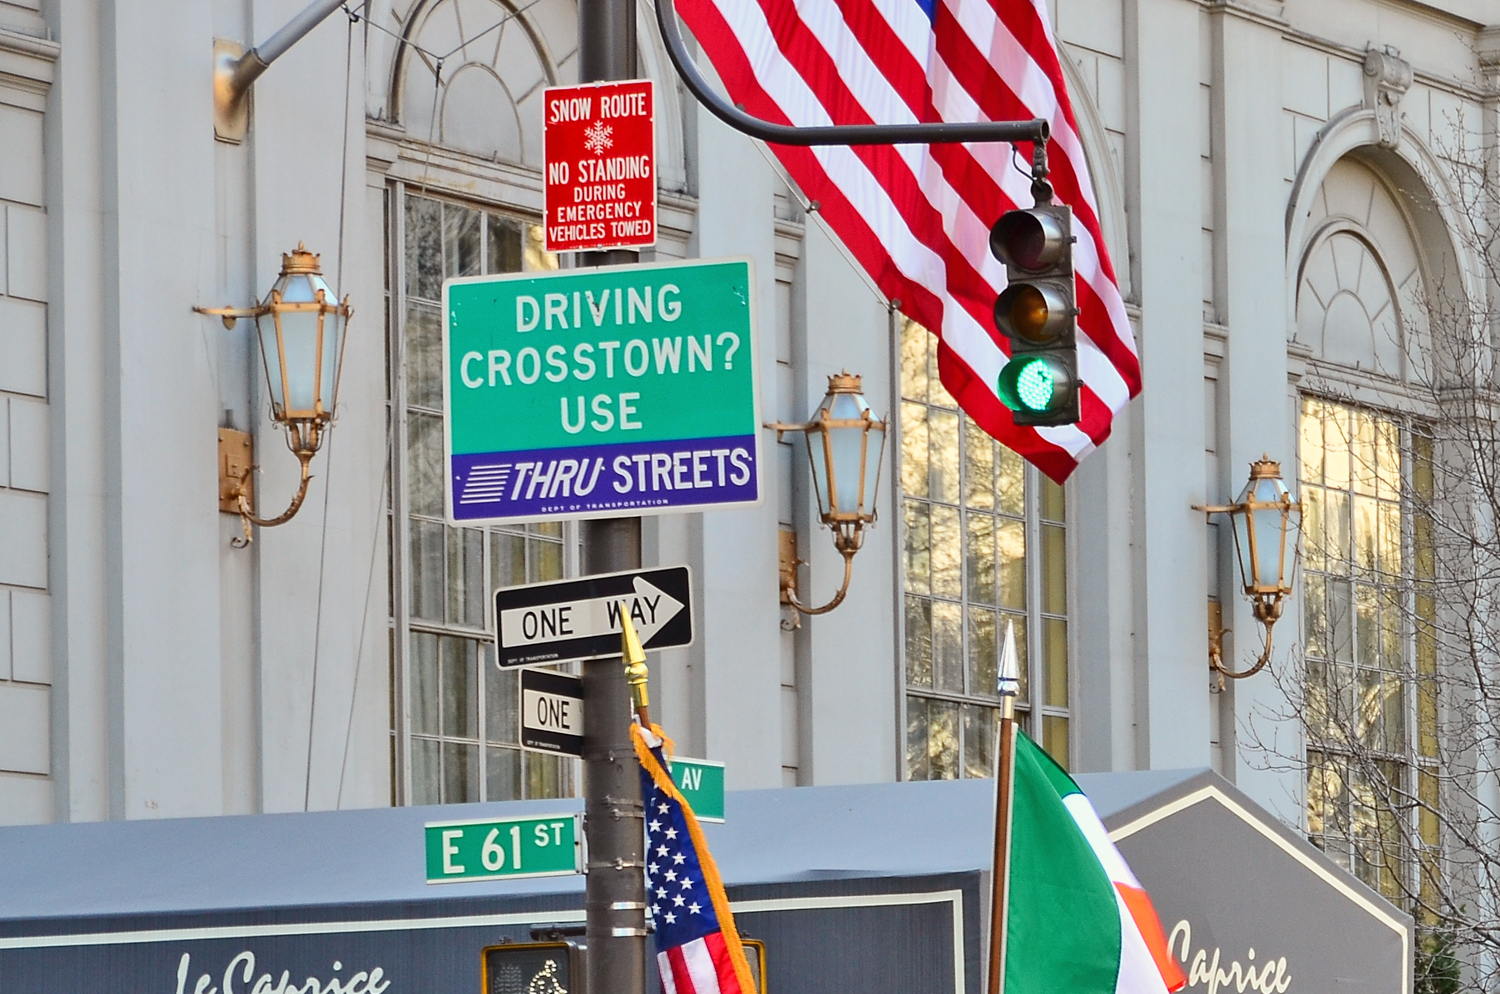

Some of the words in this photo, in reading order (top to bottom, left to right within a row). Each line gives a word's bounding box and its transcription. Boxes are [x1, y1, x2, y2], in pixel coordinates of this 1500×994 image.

[550, 97, 592, 123] SNOW
[600, 93, 647, 119] ROUTE
[549, 161, 569, 185] NO
[578, 155, 650, 183] STANDING
[574, 183, 626, 203] DURING
[557, 201, 642, 223] EMERGENCY
[549, 223, 606, 242] VEHICLES
[610, 219, 651, 238] TOWED
[516, 284, 682, 332] DRIVING
[460, 331, 741, 389] CROSSTOWN?
[560, 392, 643, 434] USE
[511, 457, 603, 501] THRU
[612, 447, 751, 494] STREETS
[541, 505, 565, 513] DEPT
[586, 498, 669, 509] TRANSPORTATION
[522, 606, 573, 640] ONE
[606, 594, 661, 629] WAY
[537, 696, 570, 730] ONE
[681, 767, 703, 791] AV
[442, 830, 465, 875] E
[481, 825, 522, 872] 61
[534, 822, 565, 847] ST
